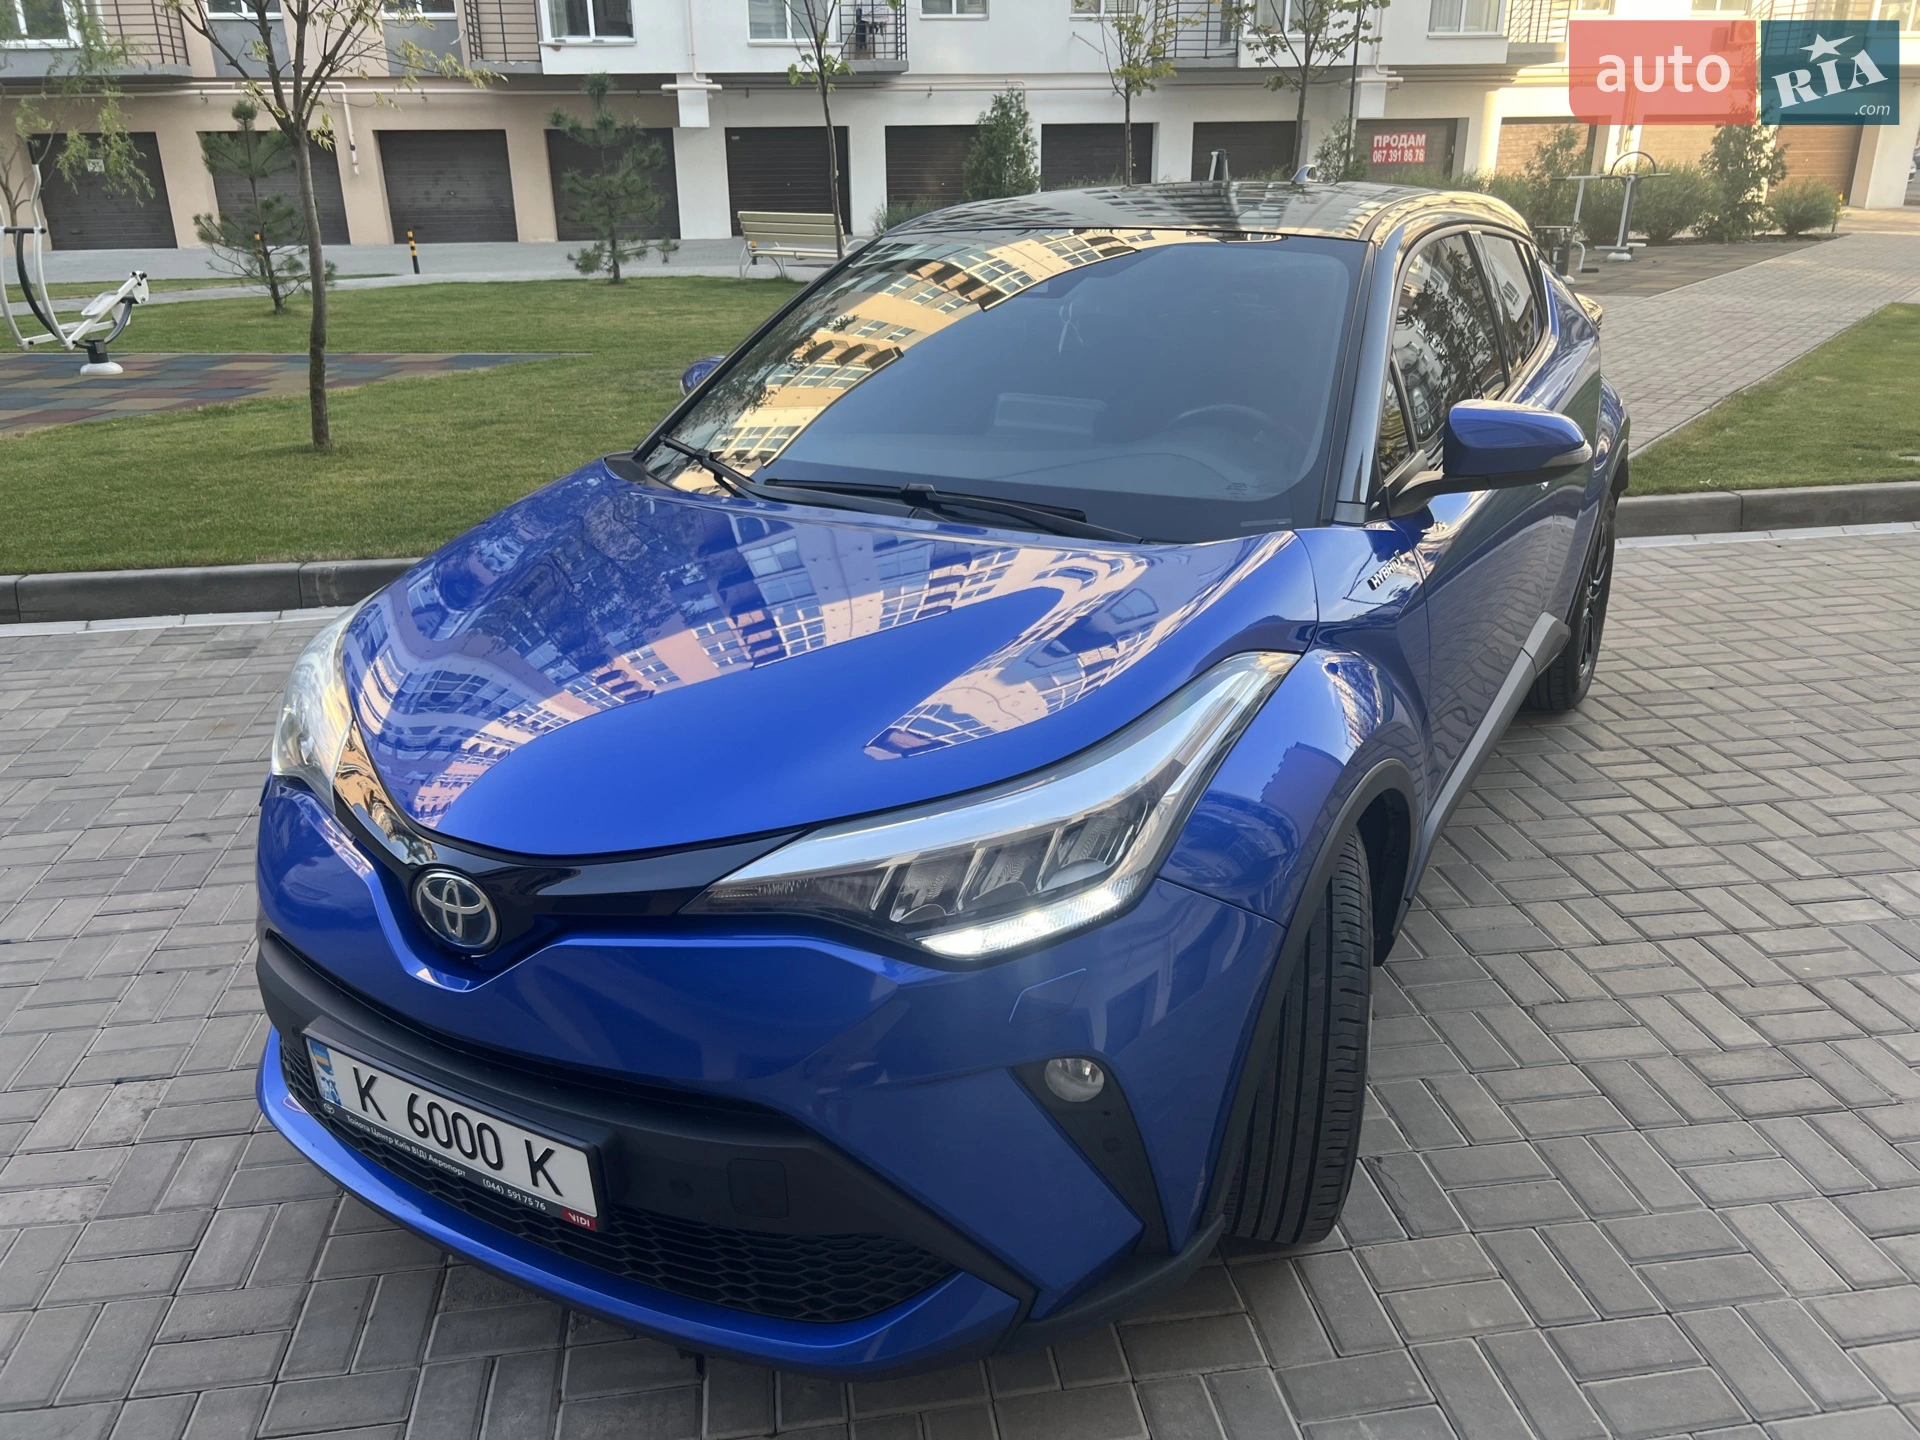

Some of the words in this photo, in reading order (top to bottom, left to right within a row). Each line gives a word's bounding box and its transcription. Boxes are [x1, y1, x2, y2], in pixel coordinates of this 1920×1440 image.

[1373, 134, 1426, 149] ПРОДАМ
[1372, 150, 1387, 163] 067
[1388, 149, 1402, 162] 391
[353, 1067, 388, 1122] K
[407, 1092, 504, 1171] 6000
[524, 1139, 564, 1197] K
[370, 1126, 394, 1144] Центр
[394, 1139, 411, 1153] Київ
[411, 1146, 428, 1160] ВІДІ
[428, 1154, 466, 1177] Аеропорт
[482, 1178, 504, 1195] (044)
[507, 1189, 521, 1201] 591
[523, 1195, 534, 1206] 75
[535, 1200, 546, 1211] 76
[568, 1212, 591, 1227] VIDI
